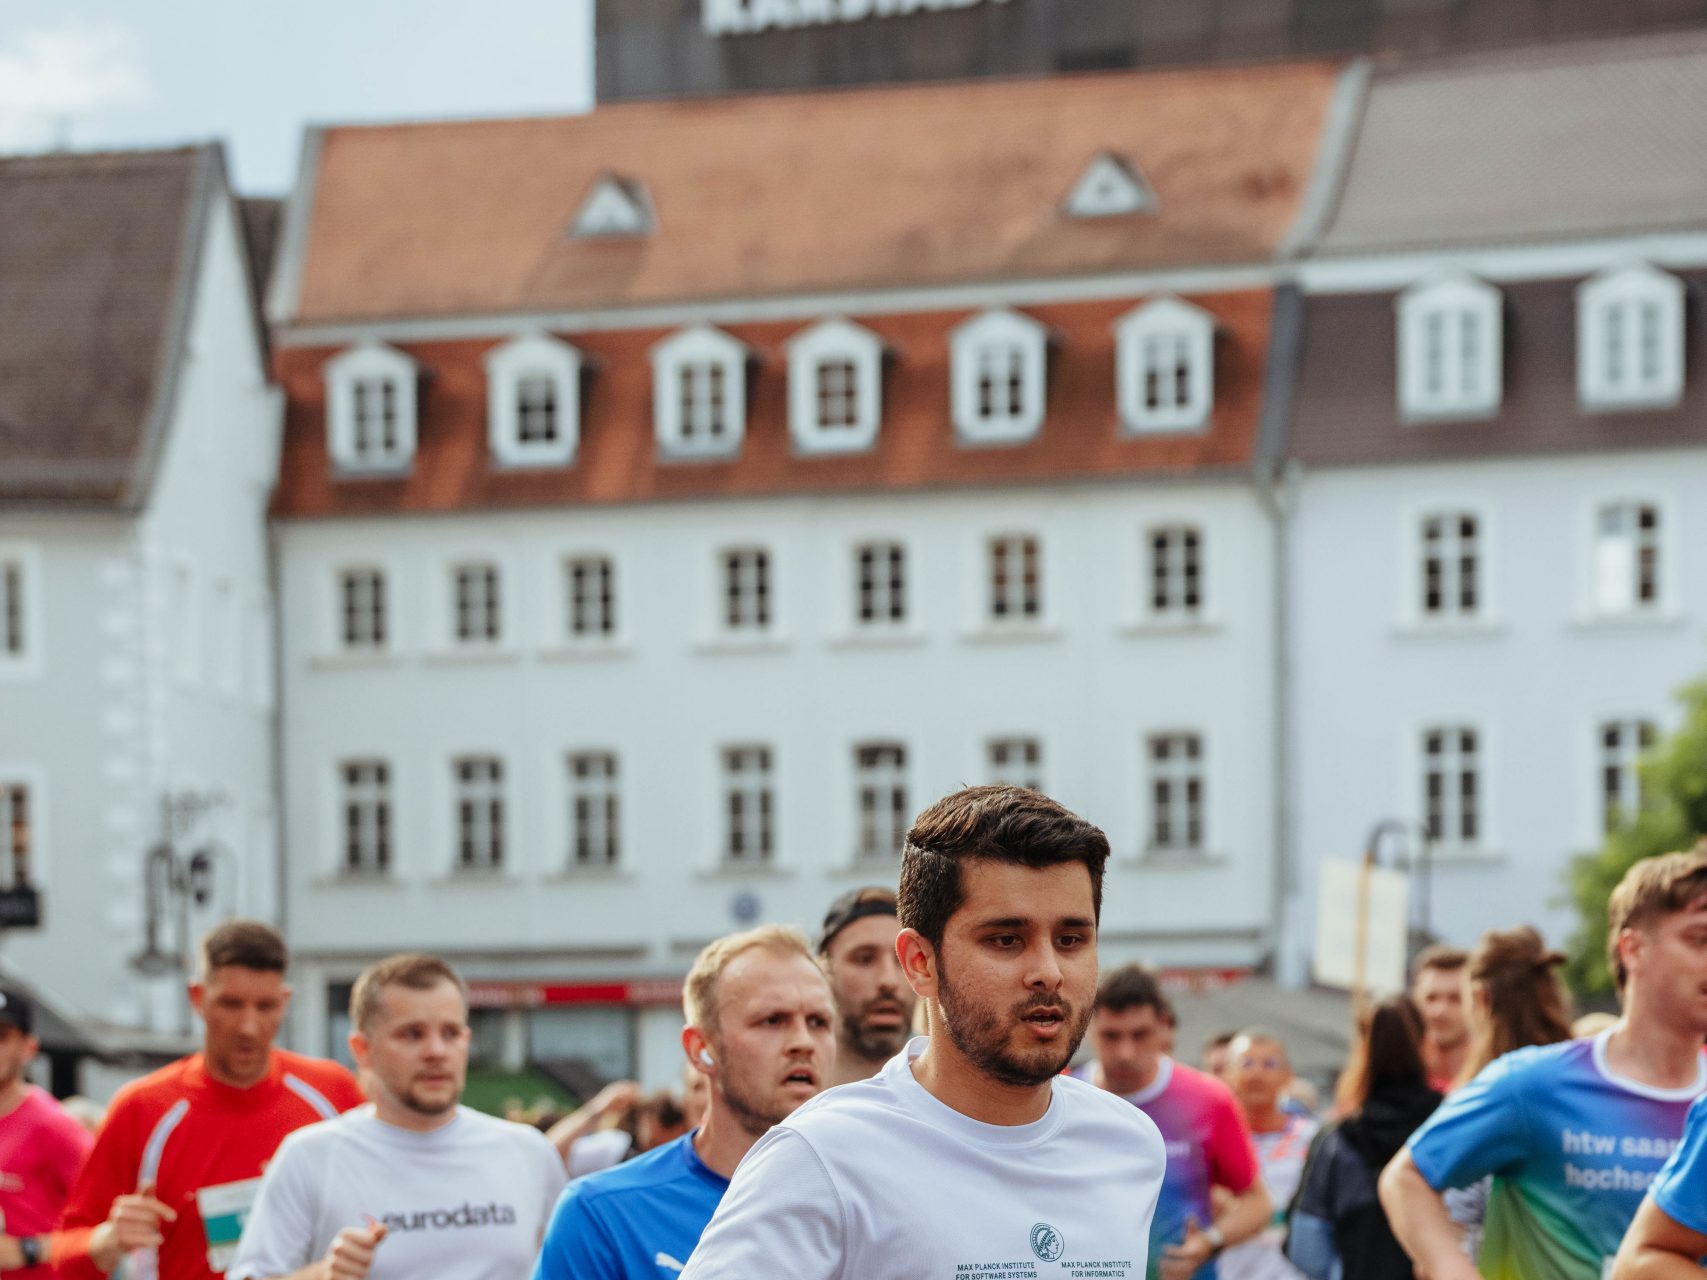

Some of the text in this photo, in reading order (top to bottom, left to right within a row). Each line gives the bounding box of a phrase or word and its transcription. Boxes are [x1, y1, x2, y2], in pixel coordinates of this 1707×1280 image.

[1563, 1128, 1616, 1155] htw
[382, 1202, 516, 1232] eurodata
[975, 1263, 1000, 1271] PLANCK
[955, 1271, 1038, 1280] FOR SOFTWARE SYSTEMS
[1071, 1270, 1125, 1278] FOR INFORMATICS
